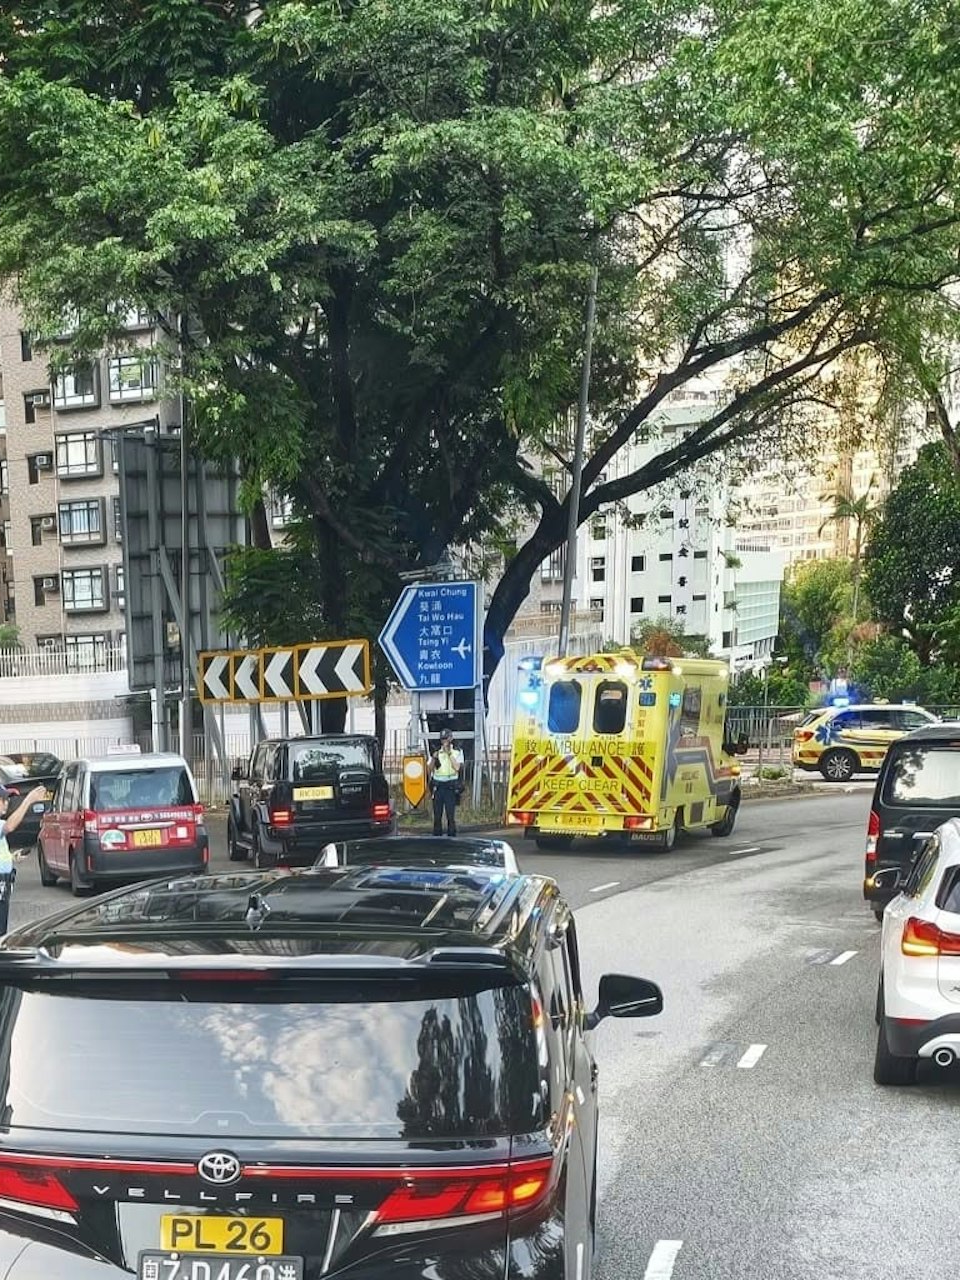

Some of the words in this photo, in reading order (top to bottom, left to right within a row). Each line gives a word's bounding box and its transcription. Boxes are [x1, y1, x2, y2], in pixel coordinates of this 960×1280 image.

[418, 589, 438, 598] Kwai
[441, 588, 467, 597] Chung
[418, 614, 430, 622] Tai
[432, 613, 445, 621] Wo
[447, 612, 464, 620] Hau
[420, 625, 453, 637] 大窩口
[418, 638, 439, 647] Tsing
[441, 637, 450, 645] Yi
[418, 661, 453, 670] Kowloon
[544, 740, 624, 756] AMBULANCE
[543, 779, 575, 790] KEEP
[578, 779, 618, 791] CLEAR
[92, 1185, 355, 1204] VELLFIRE
[171, 1218, 216, 1249] PL
[226, 1220, 271, 1251] 26
